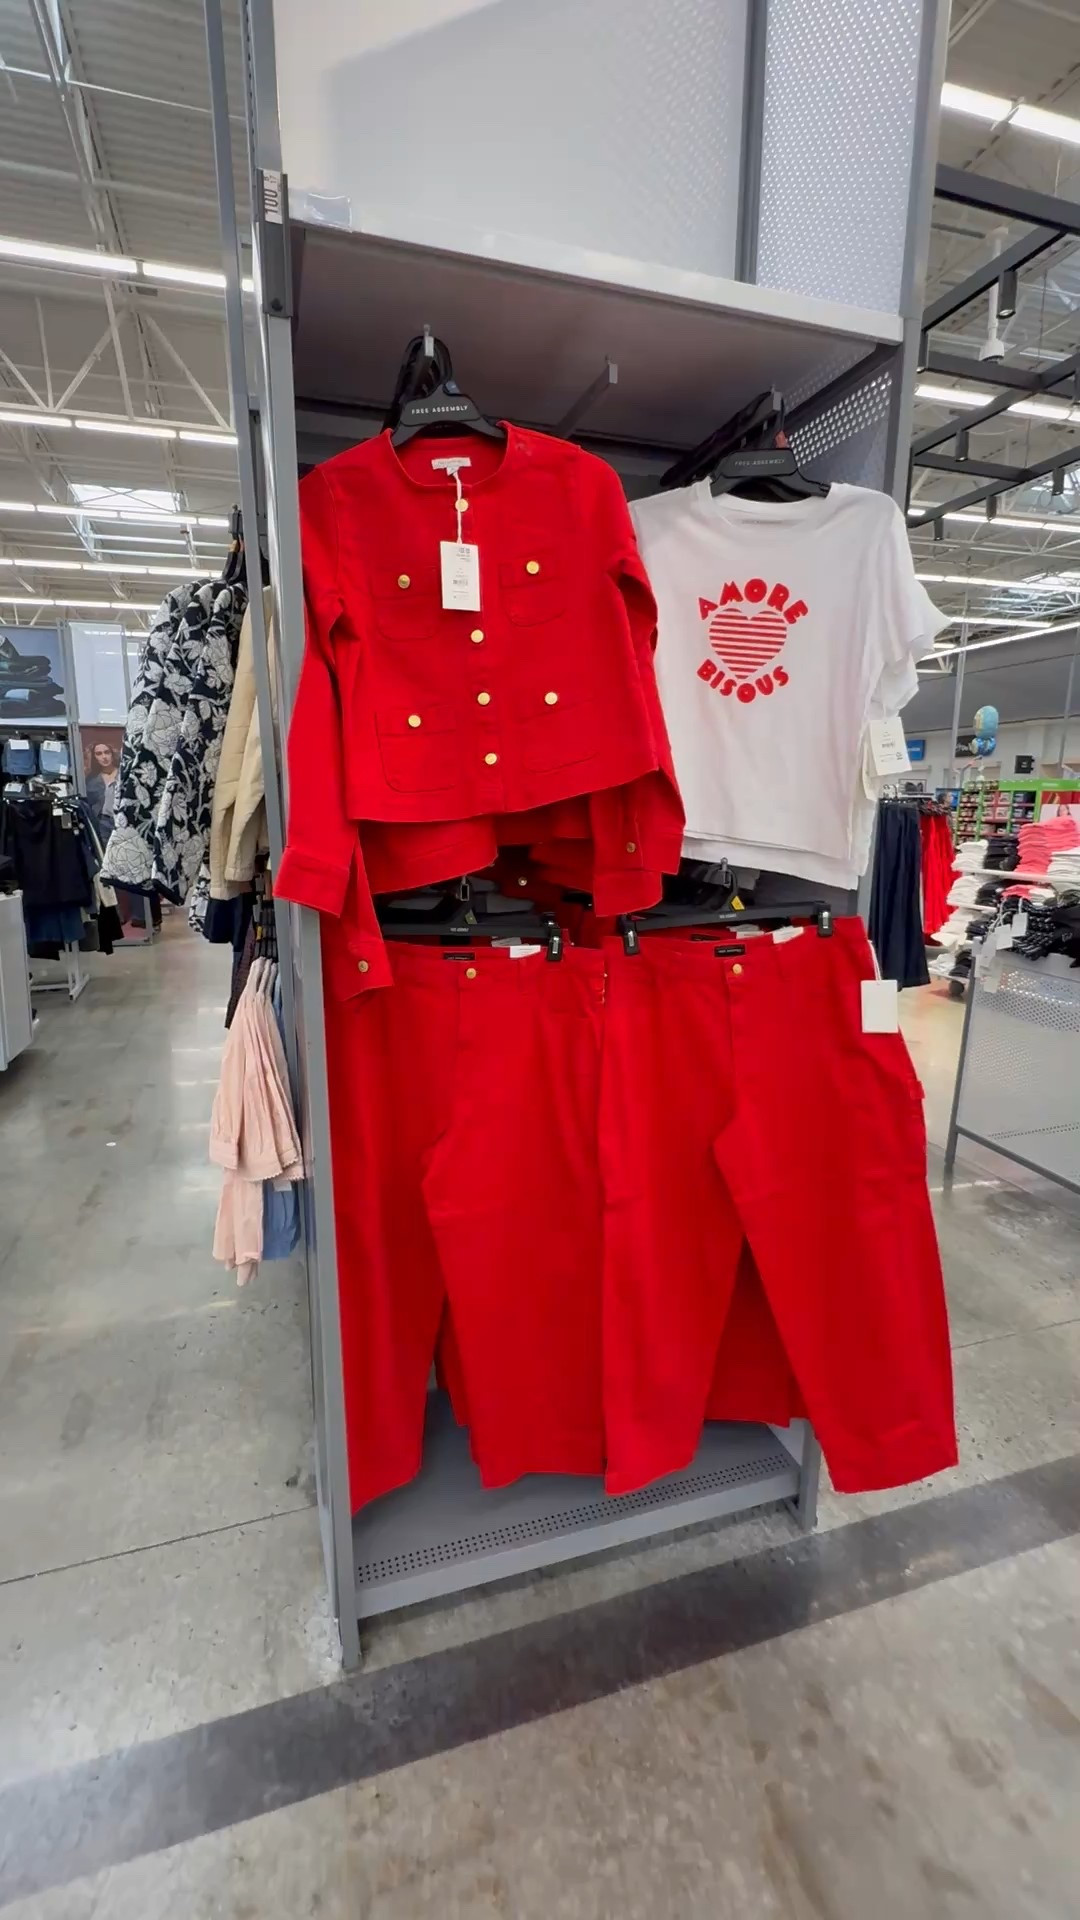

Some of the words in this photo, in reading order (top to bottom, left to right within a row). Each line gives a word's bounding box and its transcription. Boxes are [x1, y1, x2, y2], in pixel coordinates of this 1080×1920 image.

[263, 188, 278, 215] 100
[411, 407, 429, 415] FREE
[432, 405, 468, 413] ASSEMBLY
[698, 578, 809, 624] AMORE
[696, 658, 790, 704] BISOUS
